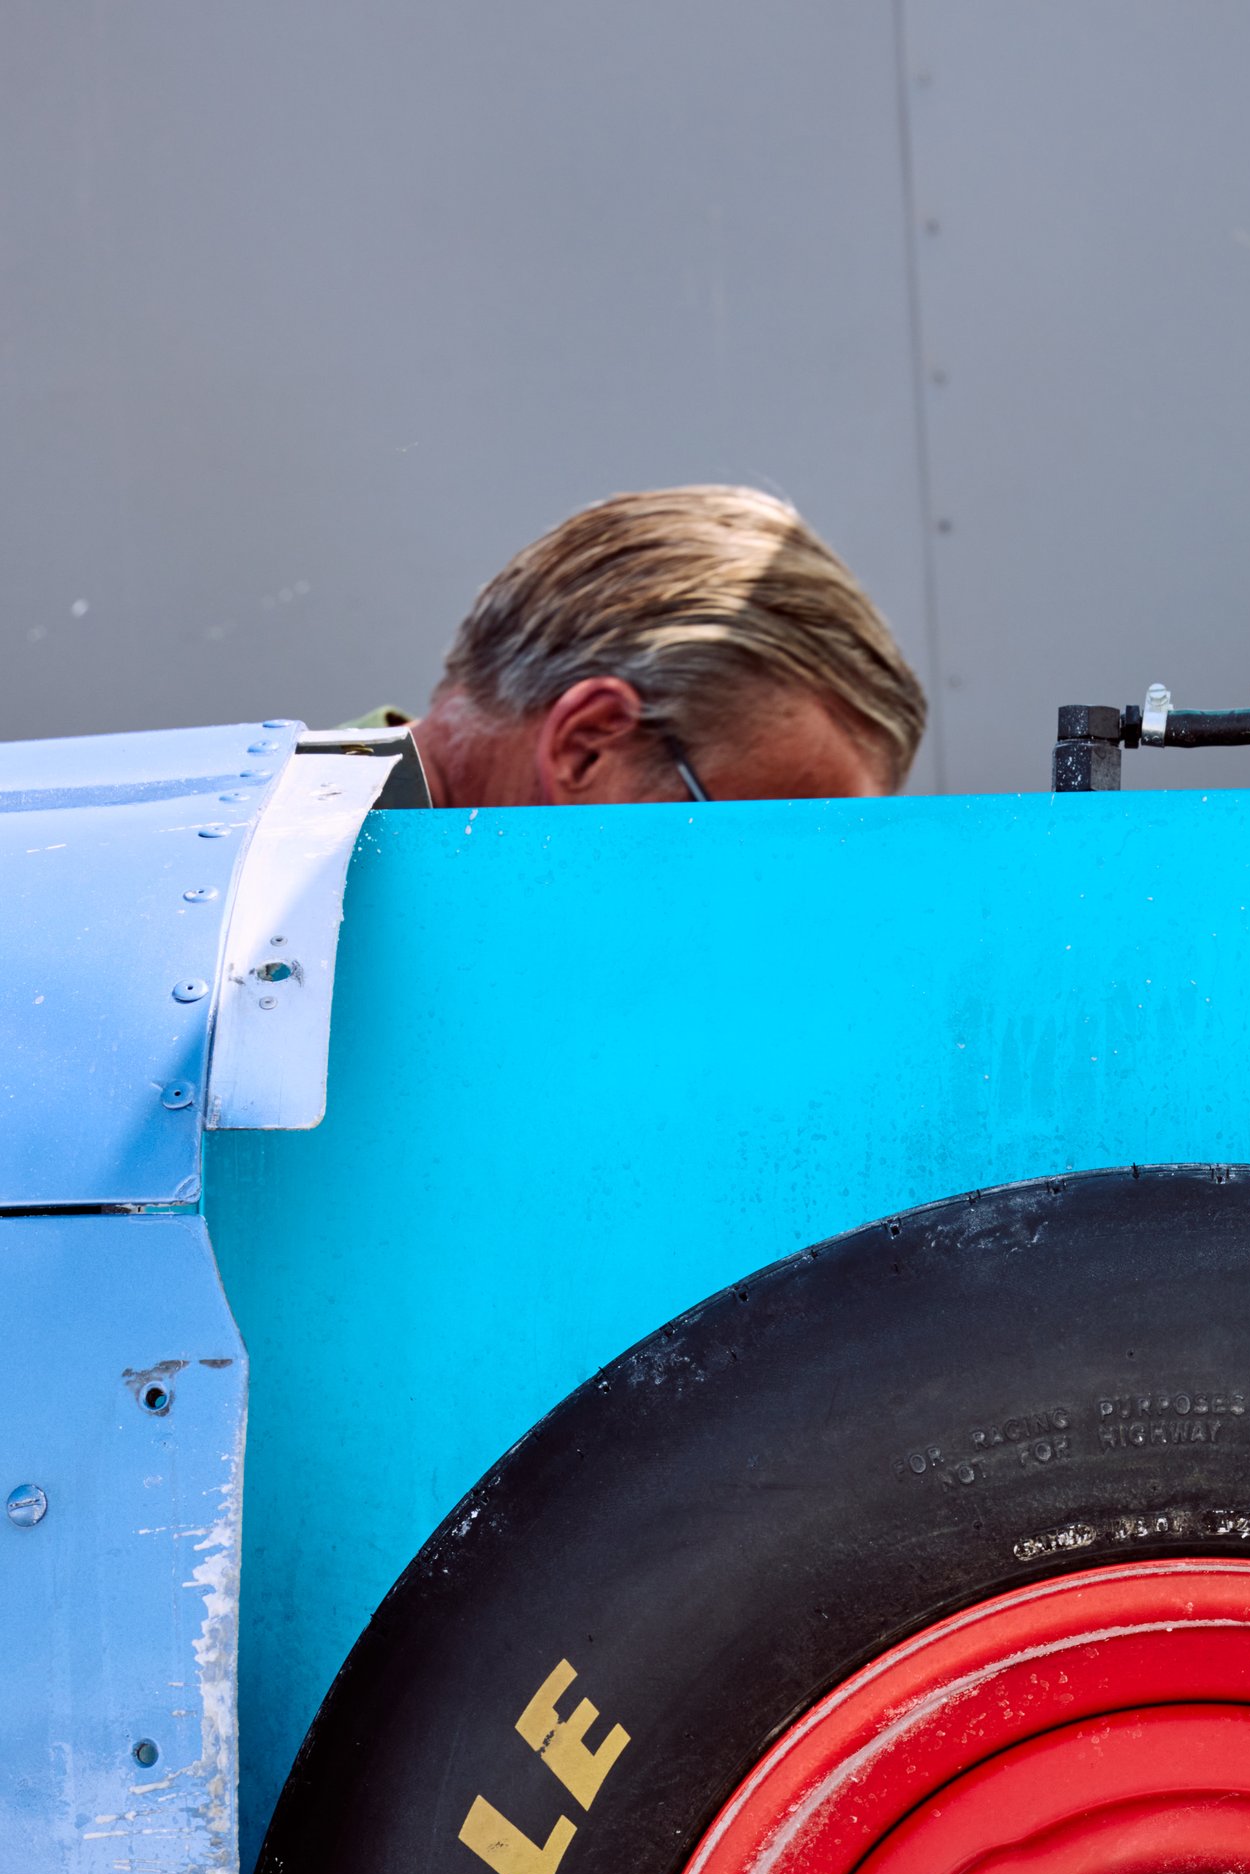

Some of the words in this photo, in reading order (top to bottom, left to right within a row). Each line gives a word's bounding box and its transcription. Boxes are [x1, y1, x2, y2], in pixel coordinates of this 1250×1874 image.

[892, 1446, 944, 1477] FOR
[970, 1409, 1071, 1452] RACING
[1099, 1394, 1247, 1423] PURPOSES
[937, 1457, 988, 1493] NOT
[1018, 1434, 1071, 1467] FOR
[1099, 1420, 1224, 1451] HIGHWAY
